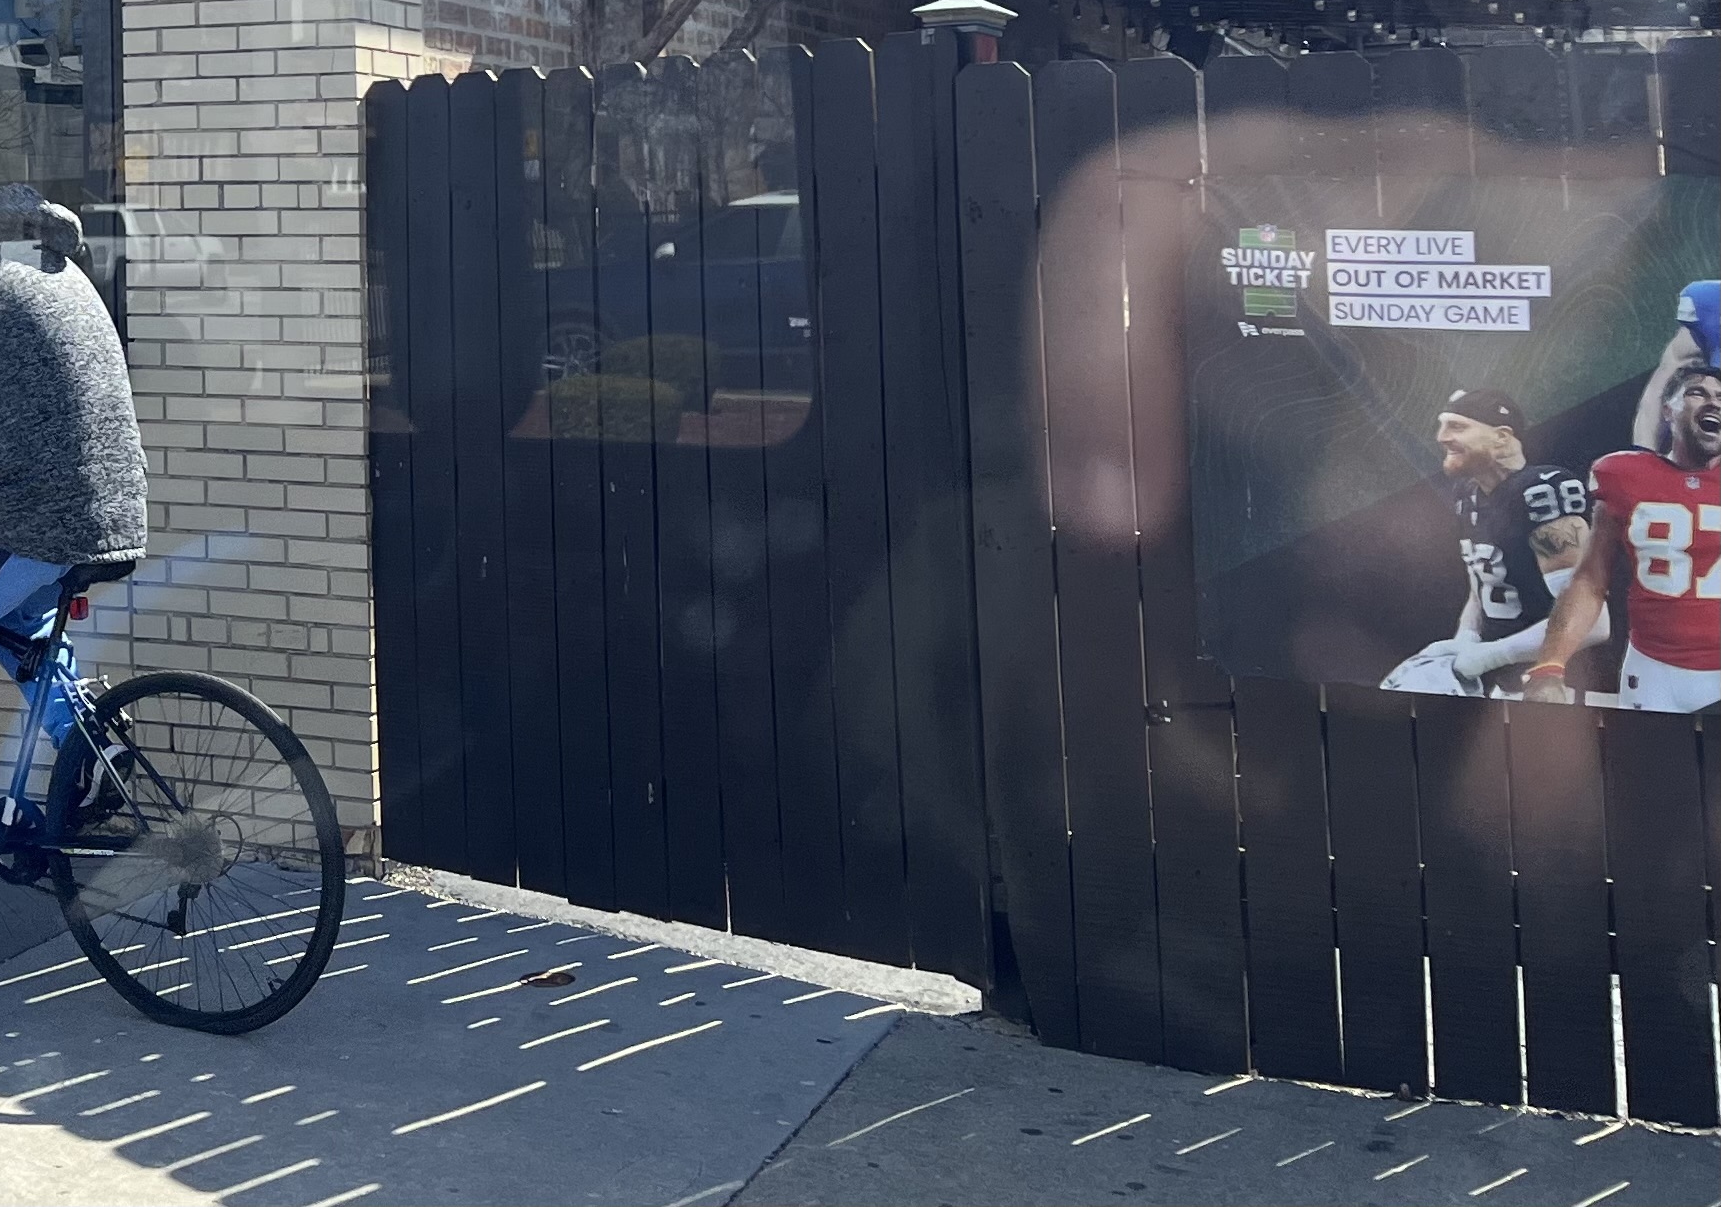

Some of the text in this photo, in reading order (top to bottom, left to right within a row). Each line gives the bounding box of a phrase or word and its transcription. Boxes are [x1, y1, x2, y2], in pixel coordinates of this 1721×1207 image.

[1331, 235, 1464, 256] EVERY LIVE
[1221, 248, 1316, 269] SUNDAY
[1226, 267, 1312, 289] TICKET
[1332, 269, 1546, 290] OUT OF MARKET
[1334, 302, 1520, 325] SUNDAY GAME
[1523, 479, 1587, 523] 98
